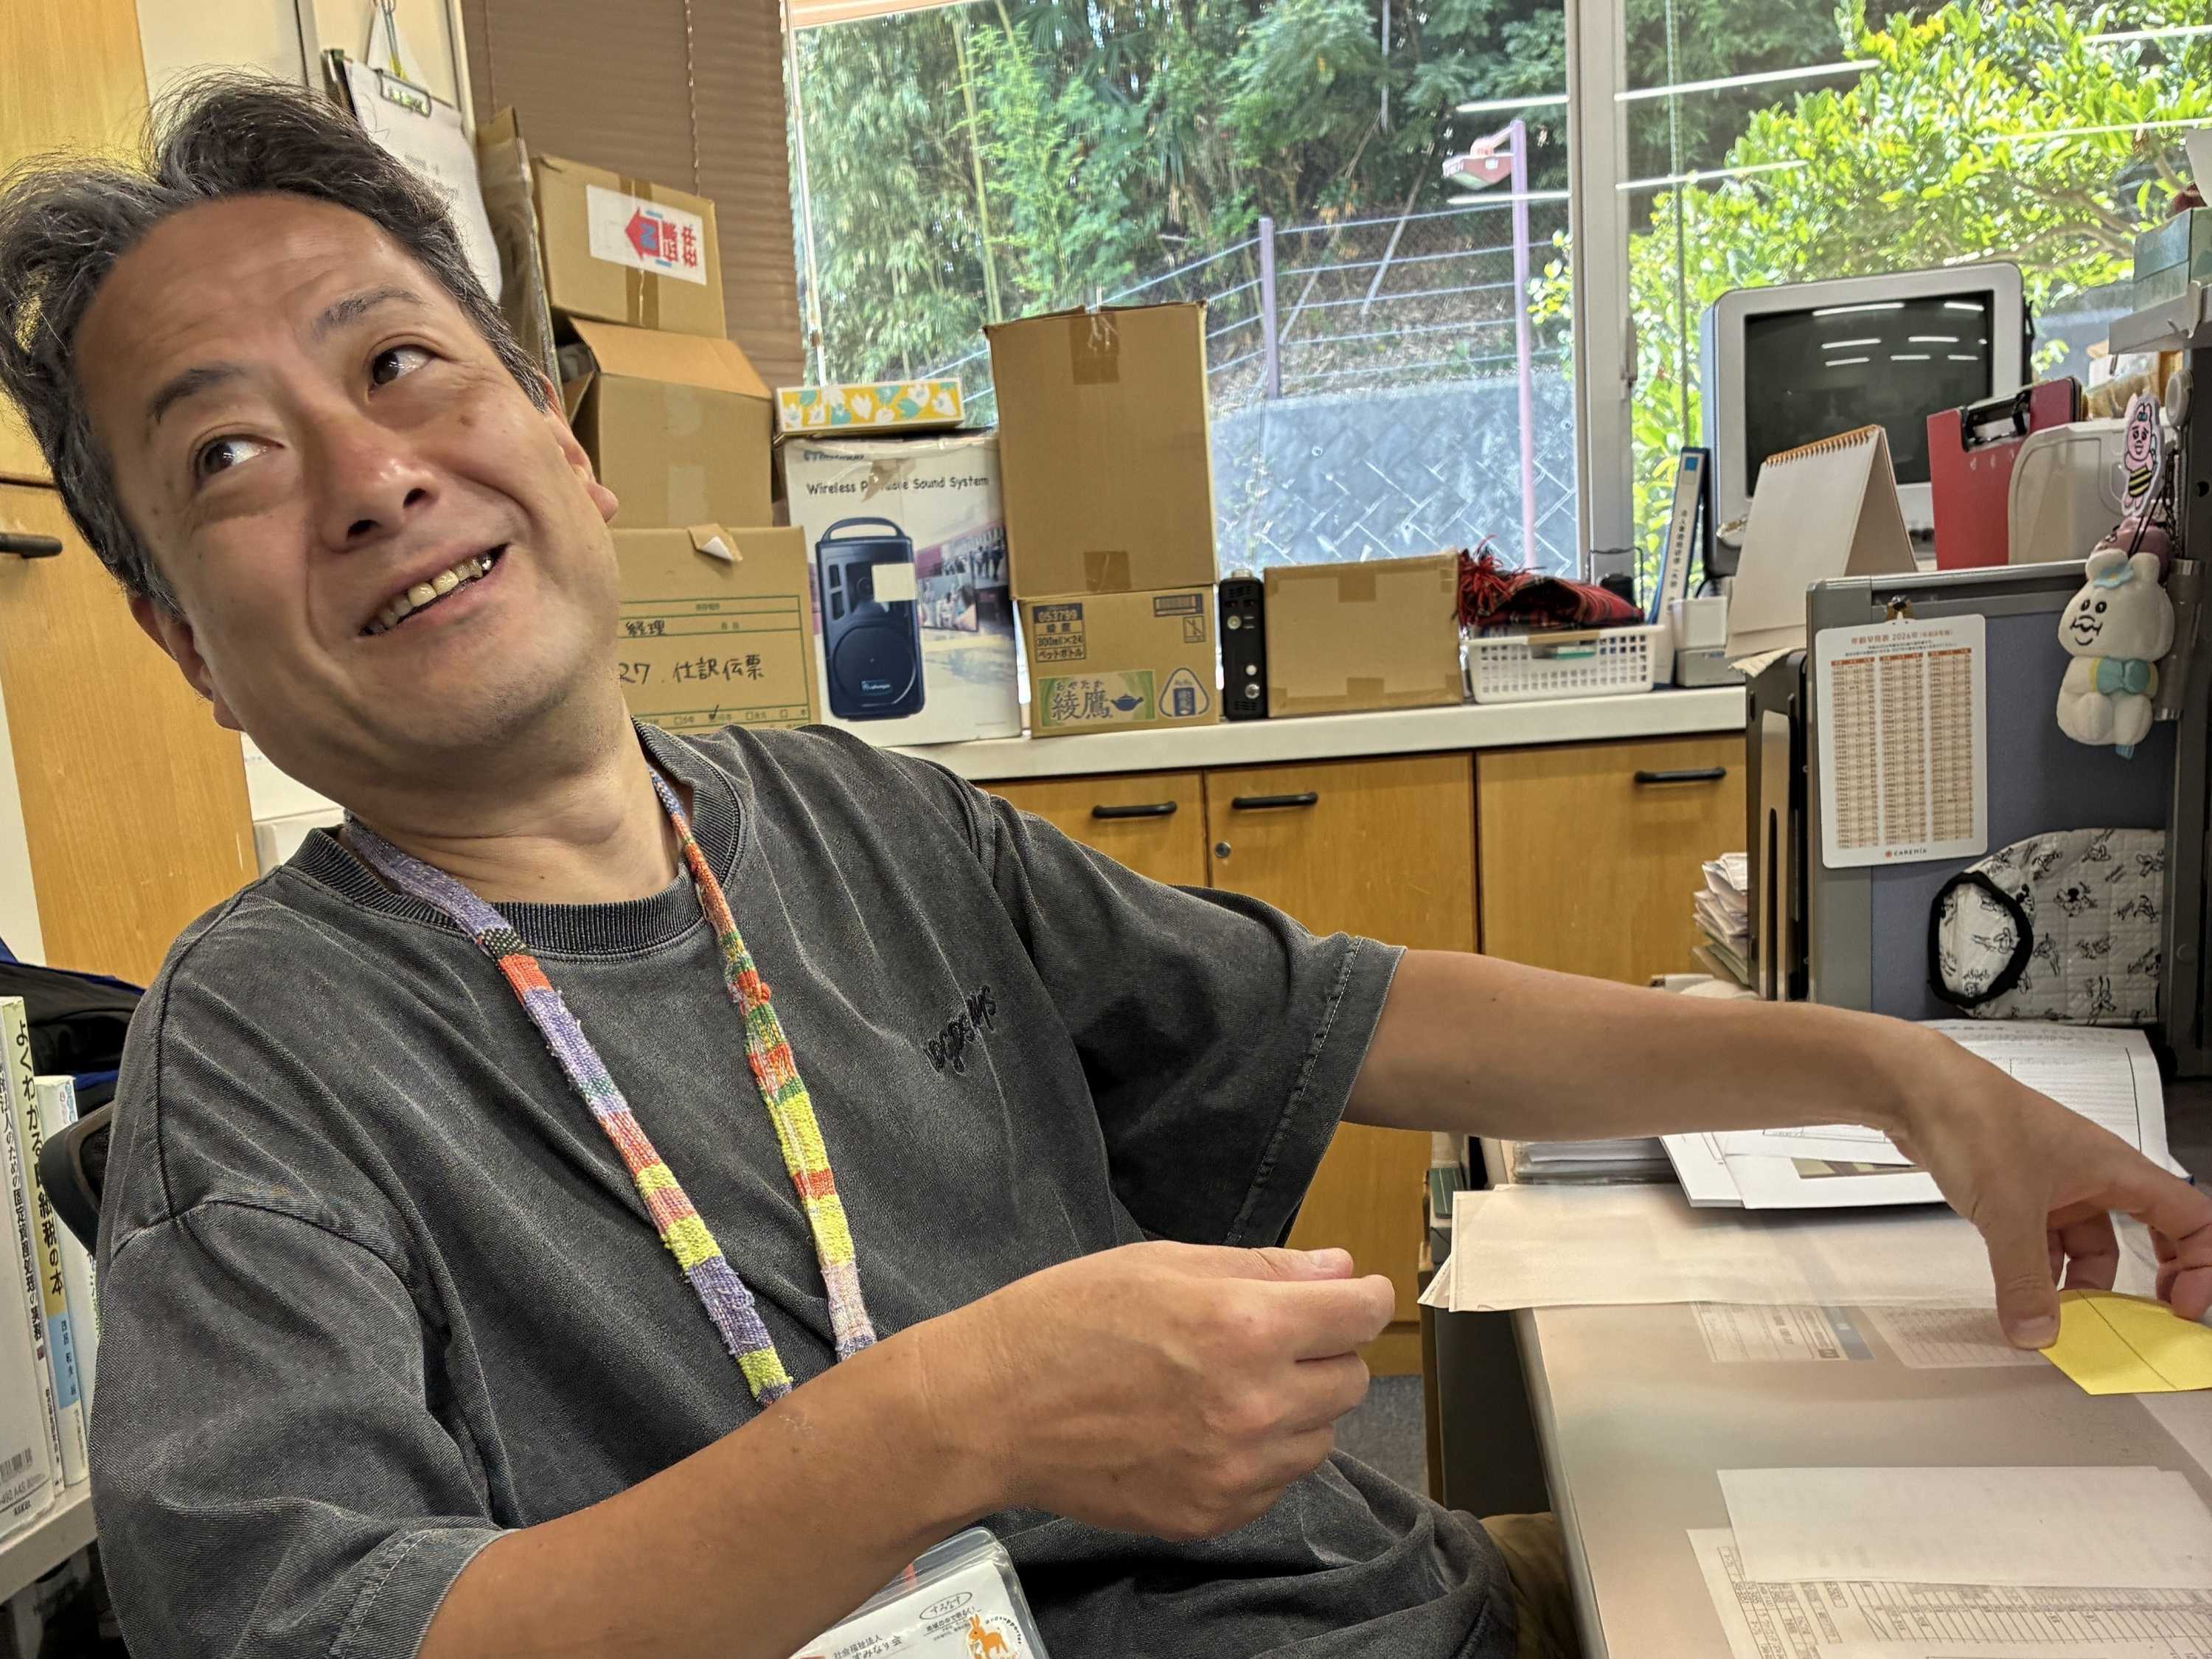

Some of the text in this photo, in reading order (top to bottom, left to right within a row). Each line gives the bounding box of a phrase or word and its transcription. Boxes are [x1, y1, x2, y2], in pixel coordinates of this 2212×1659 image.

[806, 481, 856, 495] Wireless
[914, 477, 946, 489] Sound
[950, 476, 990, 490] System
[672, 654, 765, 684] 仕訳伝票
[1055, 678, 1105, 692] あやたか
[1051, 688, 1113, 720] 綾鷹
